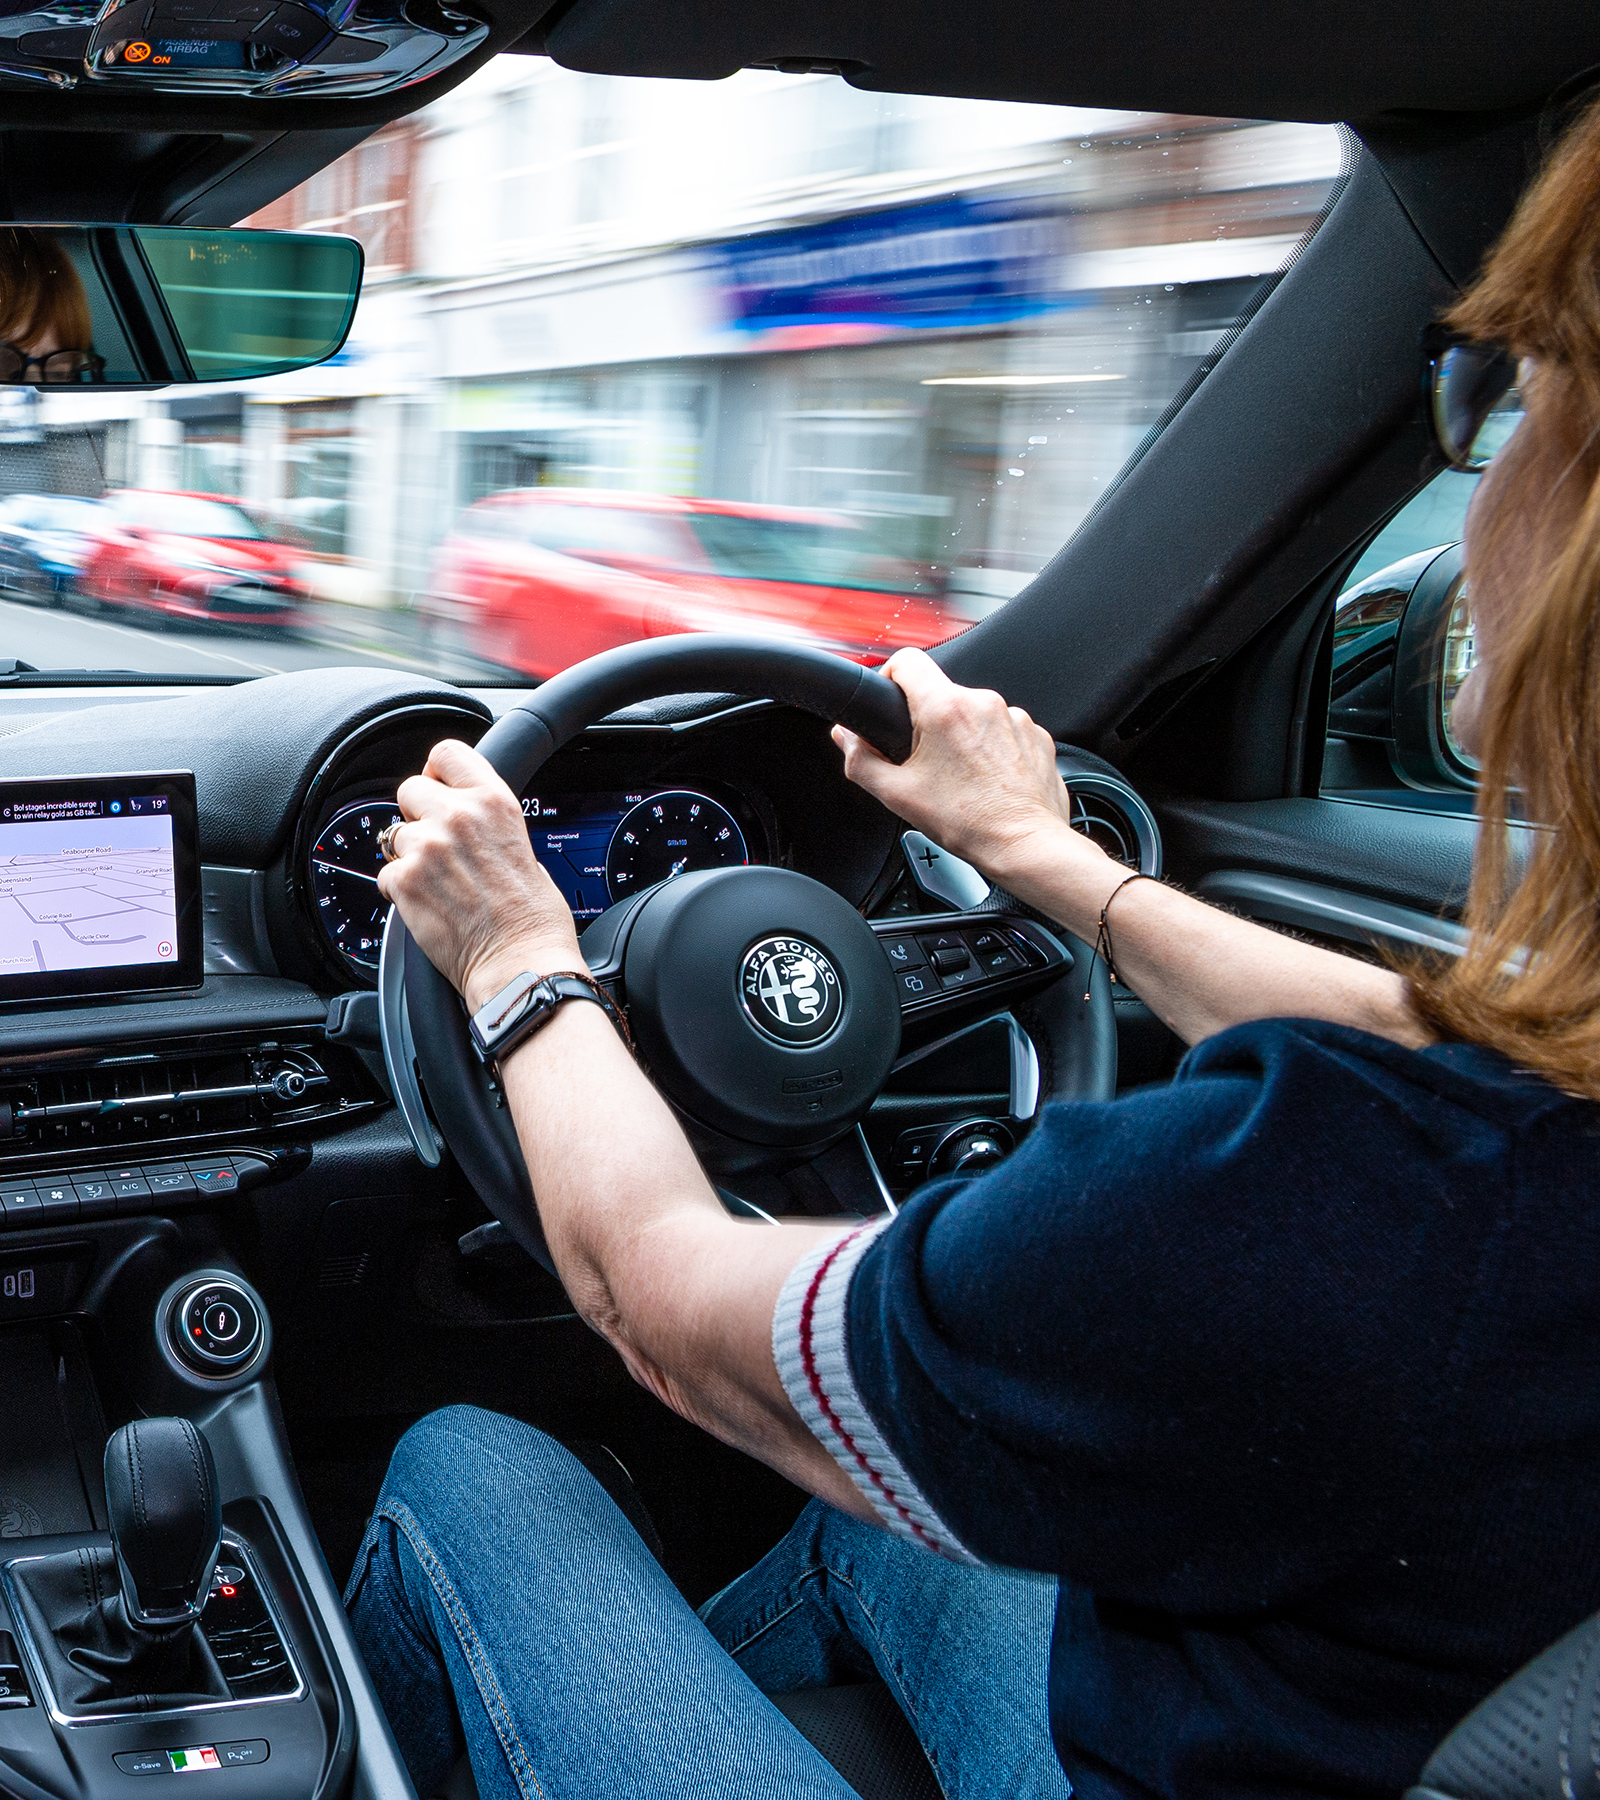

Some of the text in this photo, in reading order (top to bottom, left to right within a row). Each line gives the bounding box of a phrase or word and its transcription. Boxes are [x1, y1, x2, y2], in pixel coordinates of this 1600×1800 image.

[165, 46, 208, 54] AIRBAG
[153, 56, 171, 64] ON
[625, 795, 641, 803] 16:10
[25, 804, 46, 812] stages
[47, 801, 78, 810] incredible
[152, 800, 166, 809] 19°
[521, 798, 557, 817] 23 MPH
[34, 811, 50, 819] relay
[51, 810, 65, 819] gold
[652, 805, 663, 817] 30
[690, 804, 700, 816] 40
[361, 816, 370, 828] 60
[624, 832, 635, 844] 20
[719, 827, 730, 840] 50
[333, 833, 345, 846] 40
[617, 873, 627, 883] 10
[319, 896, 330, 906] 10
[337, 923, 345, 933] 0
[746, 941, 835, 996] ALFA ROMEO
[122, 1183, 138, 1191] A/C
[216, 1575, 230, 1584] N
[222, 1586, 235, 1595] D
[134, 1762, 161, 1770] e-Save
